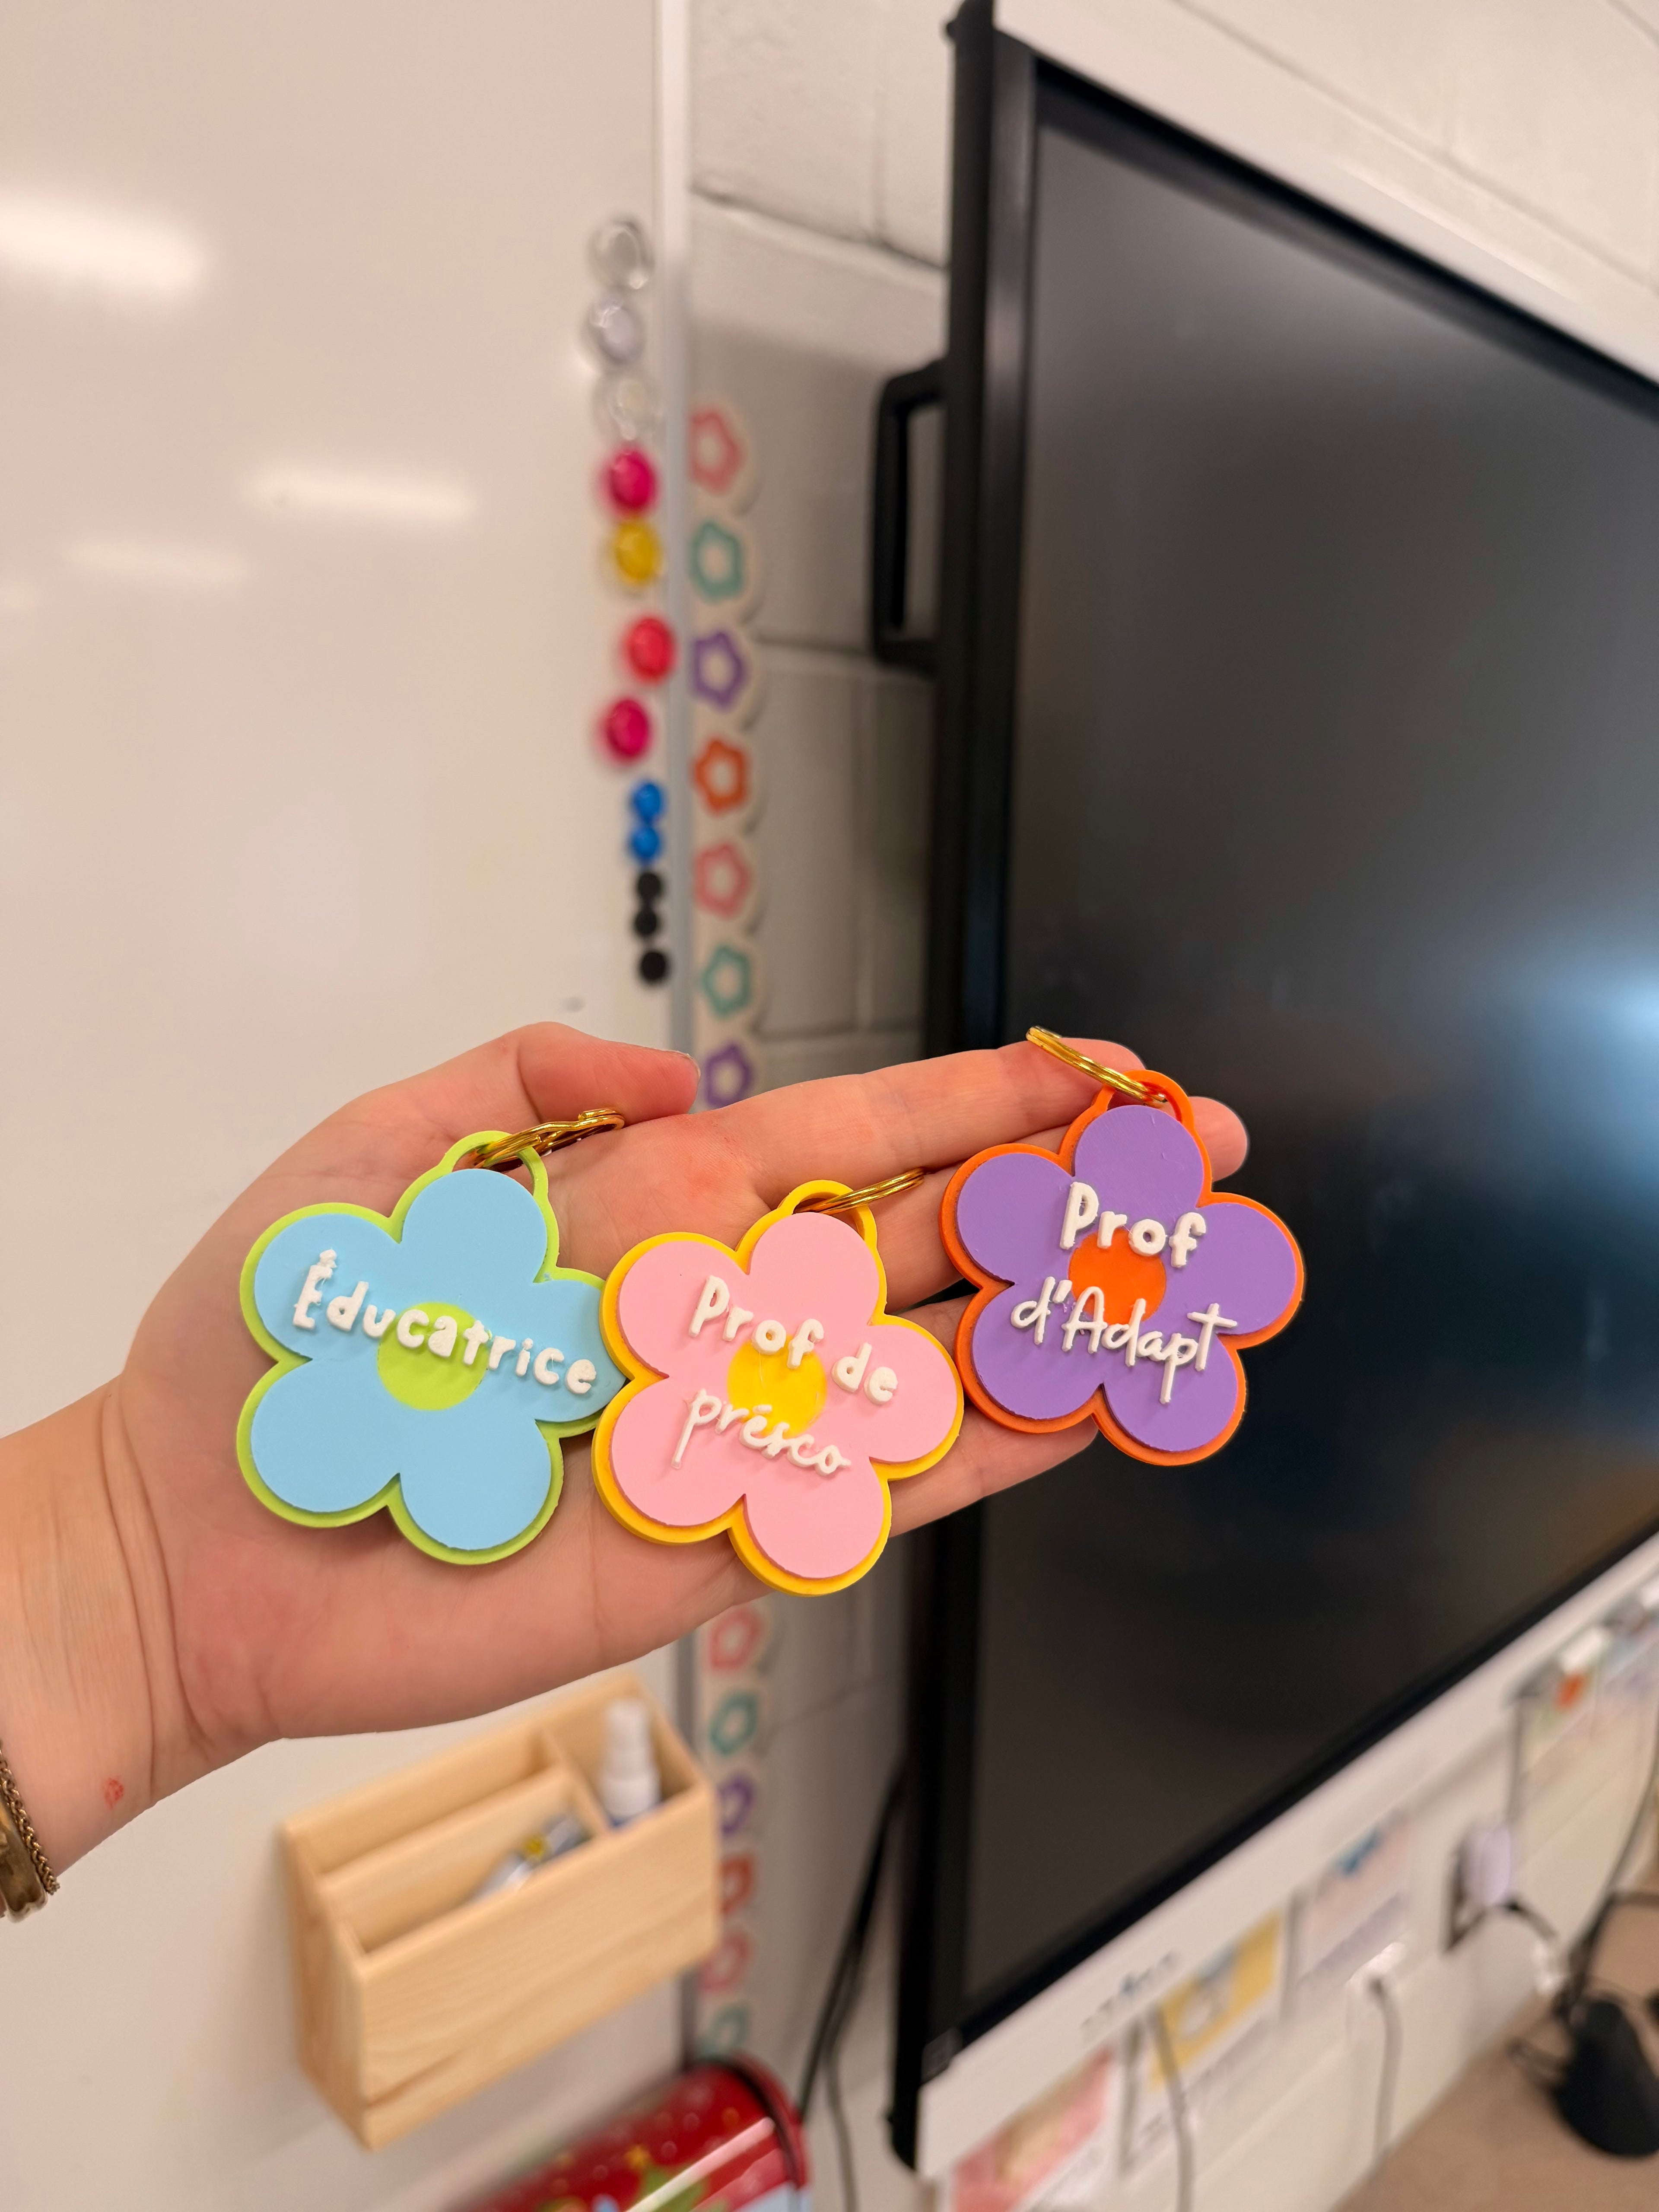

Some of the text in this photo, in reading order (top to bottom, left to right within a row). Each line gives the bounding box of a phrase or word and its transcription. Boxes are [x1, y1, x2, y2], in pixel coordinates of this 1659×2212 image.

[1059, 1182, 1206, 1268] Prof
[292, 1249, 597, 1394] Éducatrice
[688, 1275, 898, 1405] Prof de
[1011, 1276, 1237, 1404] d'Adapt
[671, 1388, 851, 1477] présco
